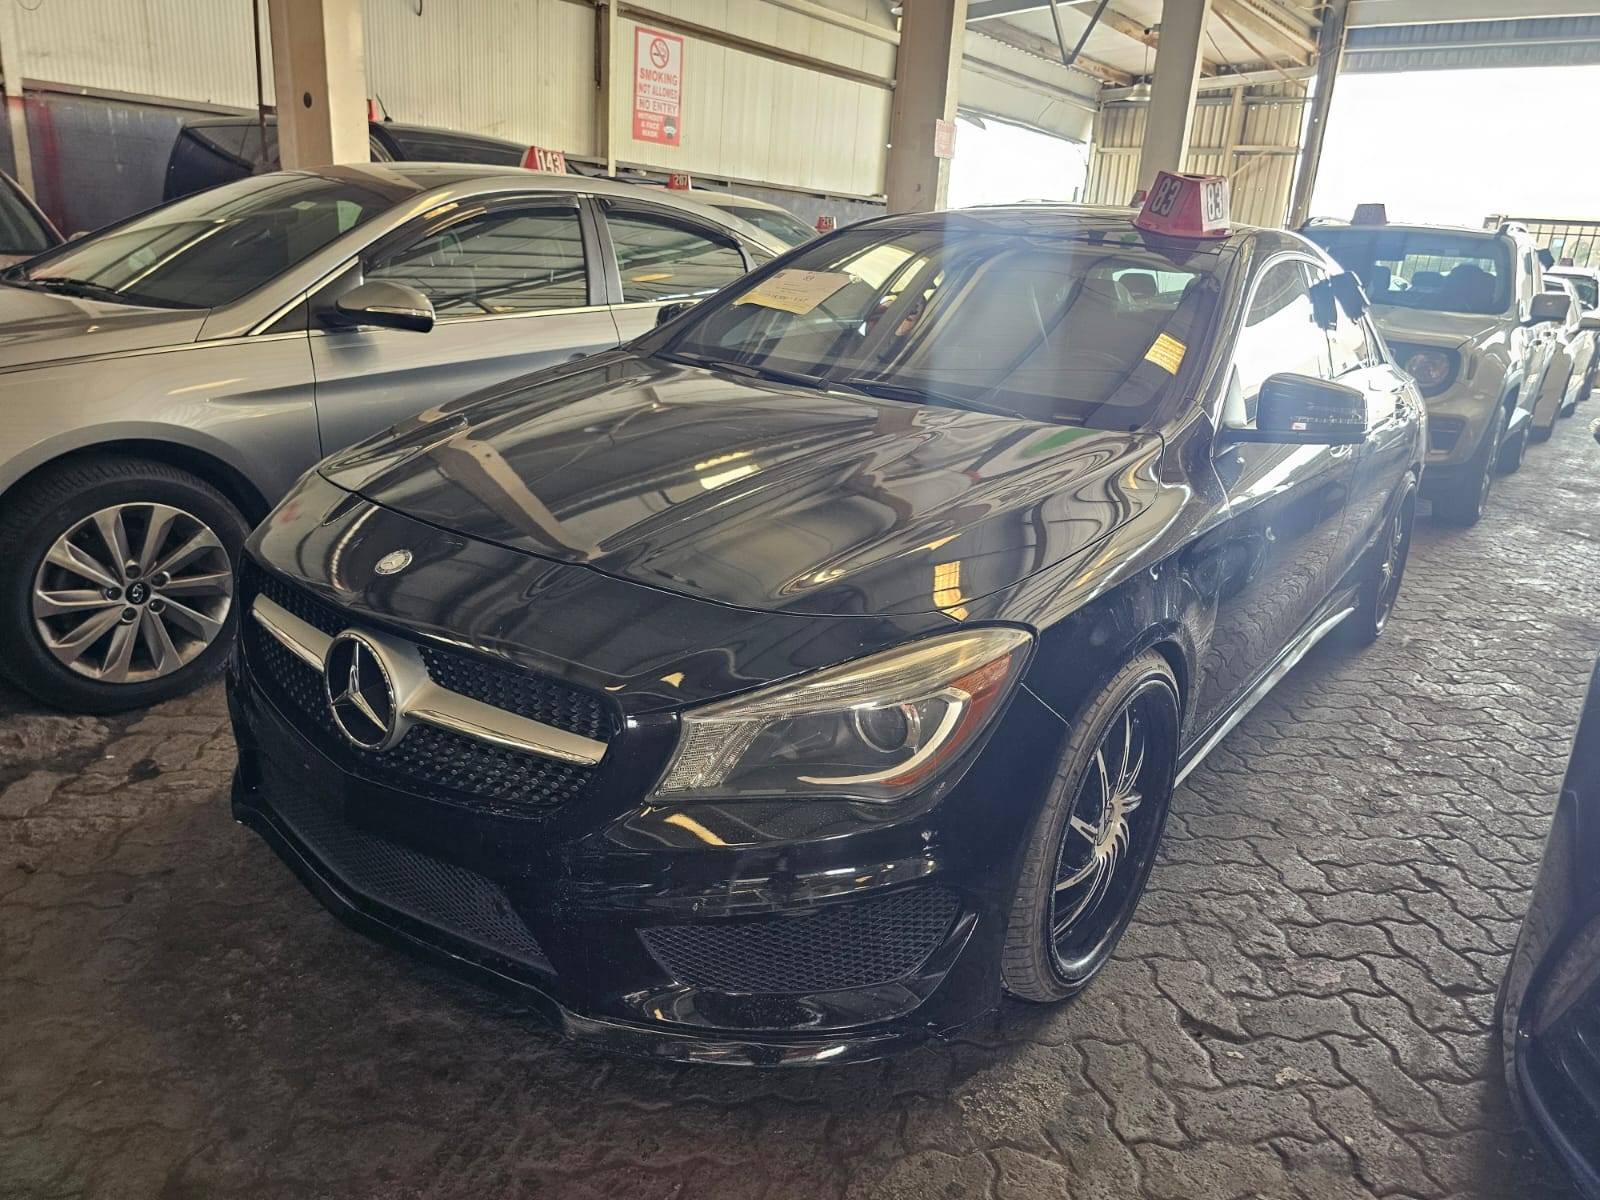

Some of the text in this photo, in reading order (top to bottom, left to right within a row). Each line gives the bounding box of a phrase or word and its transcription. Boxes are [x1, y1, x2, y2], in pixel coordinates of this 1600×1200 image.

[639, 67, 678, 86] SMOKING
[639, 82, 678, 99] NOT ALLOWED
[639, 98, 678, 115] NO ENTRY
[538, 150, 561, 173] 143
[1150, 176, 1182, 217] 83
[1206, 182, 1223, 220] 83
